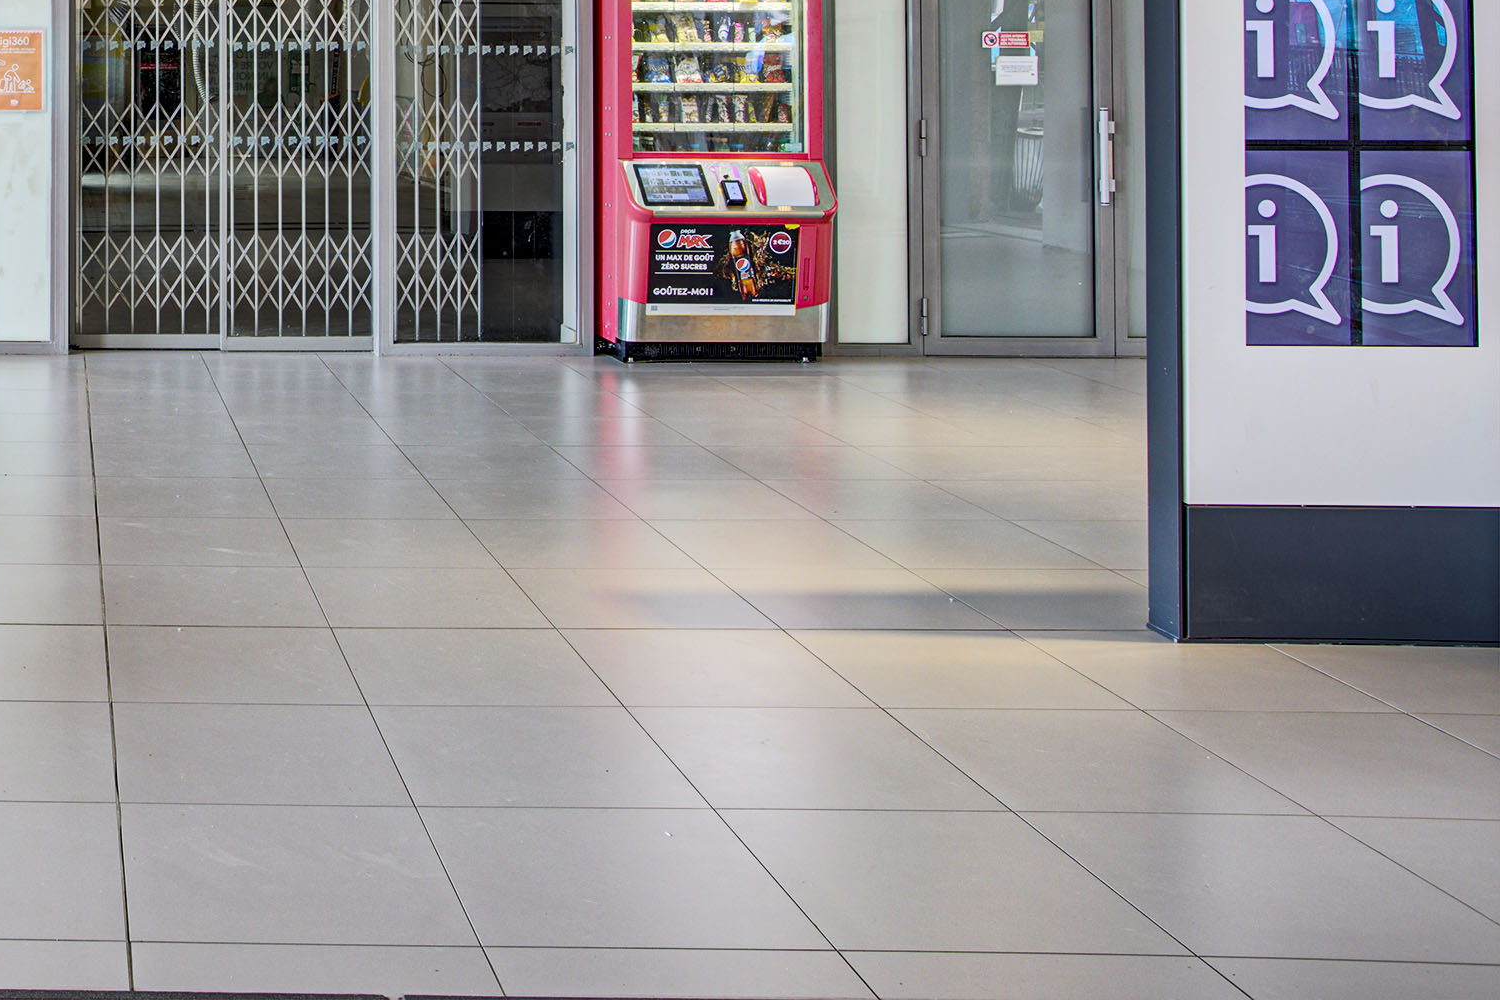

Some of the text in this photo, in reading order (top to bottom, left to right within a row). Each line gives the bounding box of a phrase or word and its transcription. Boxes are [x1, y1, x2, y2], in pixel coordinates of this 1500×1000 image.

[676, 234, 713, 249] MAX
[694, 252, 714, 261] GOÛT
[661, 262, 679, 270] ZÉRO
[653, 285, 709, 296] GOÛTEZ-MOI
